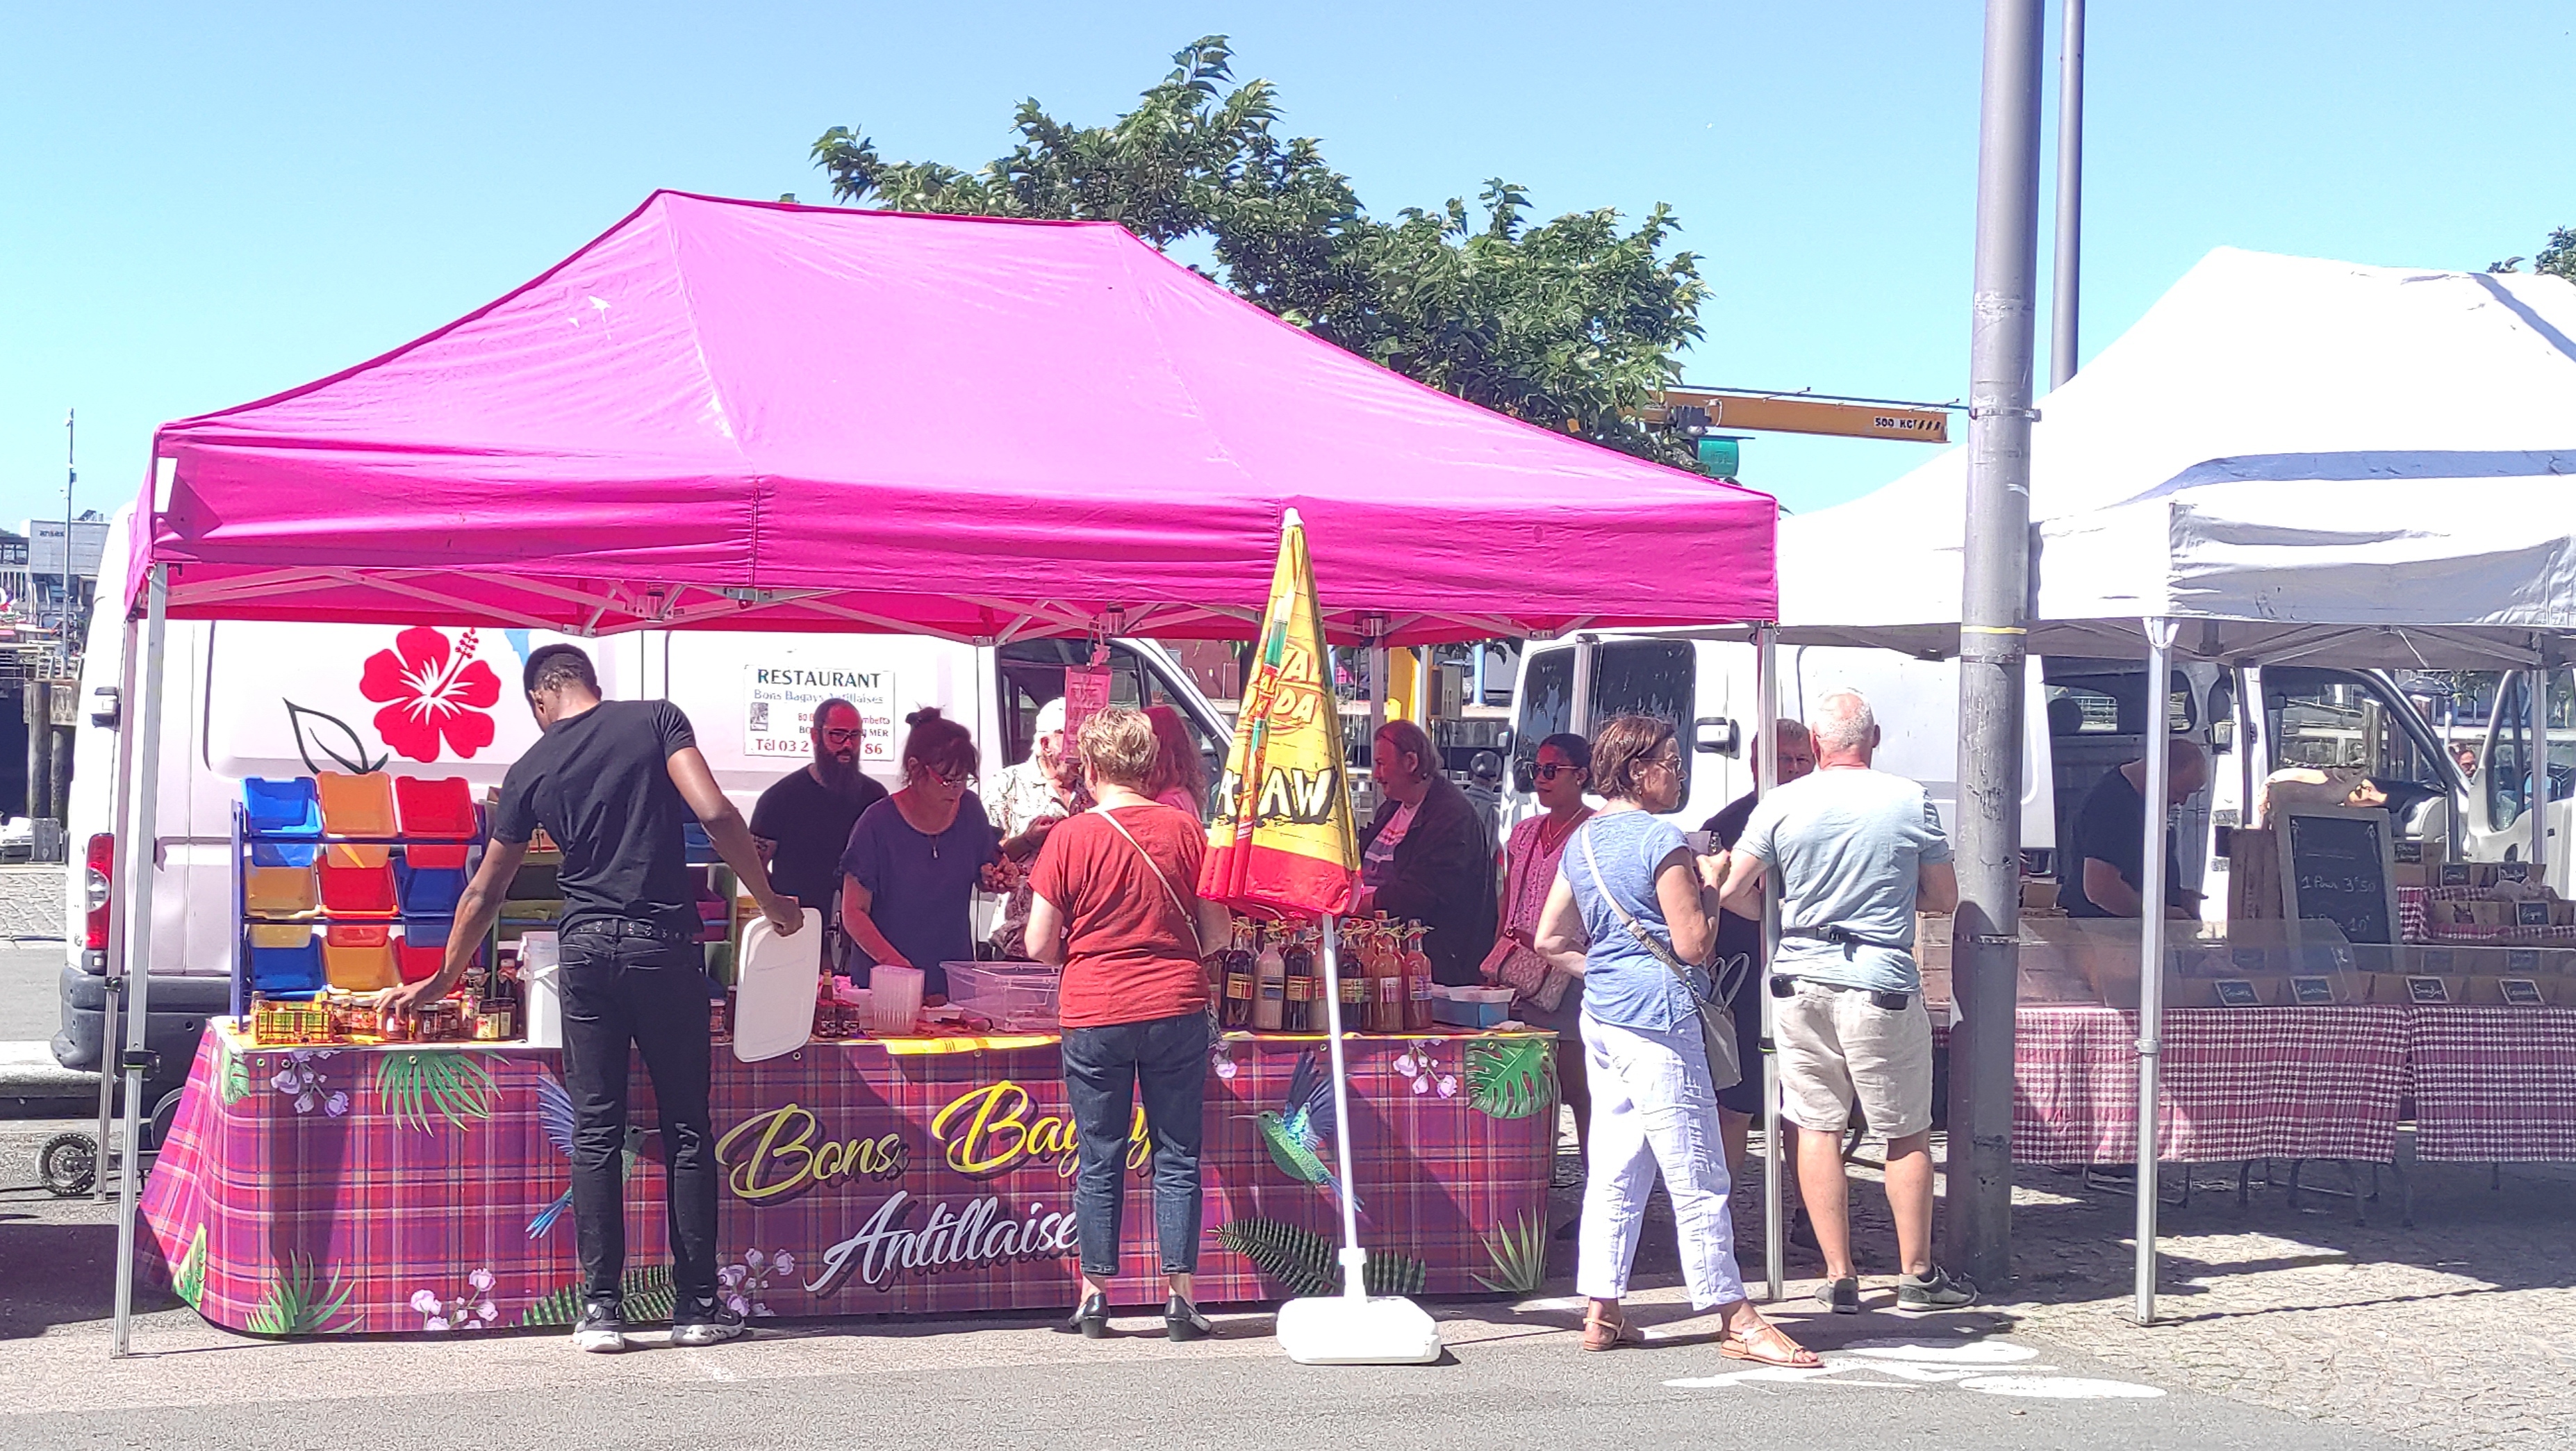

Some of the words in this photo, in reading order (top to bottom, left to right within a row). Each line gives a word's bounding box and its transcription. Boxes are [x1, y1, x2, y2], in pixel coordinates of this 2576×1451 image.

[1875, 418, 1894, 427] 500
[757, 669, 882, 689] RESTAURANT
[754, 689, 782, 700] Bons
[785, 690, 824, 703] Bagays
[869, 728, 889, 737] MER
[756, 738, 776, 751] Tél
[779, 740, 797, 752] 03
[864, 743, 883, 755] 86
[714, 1103, 900, 1199] Bons
[802, 1190, 1079, 1293] Antillaise
